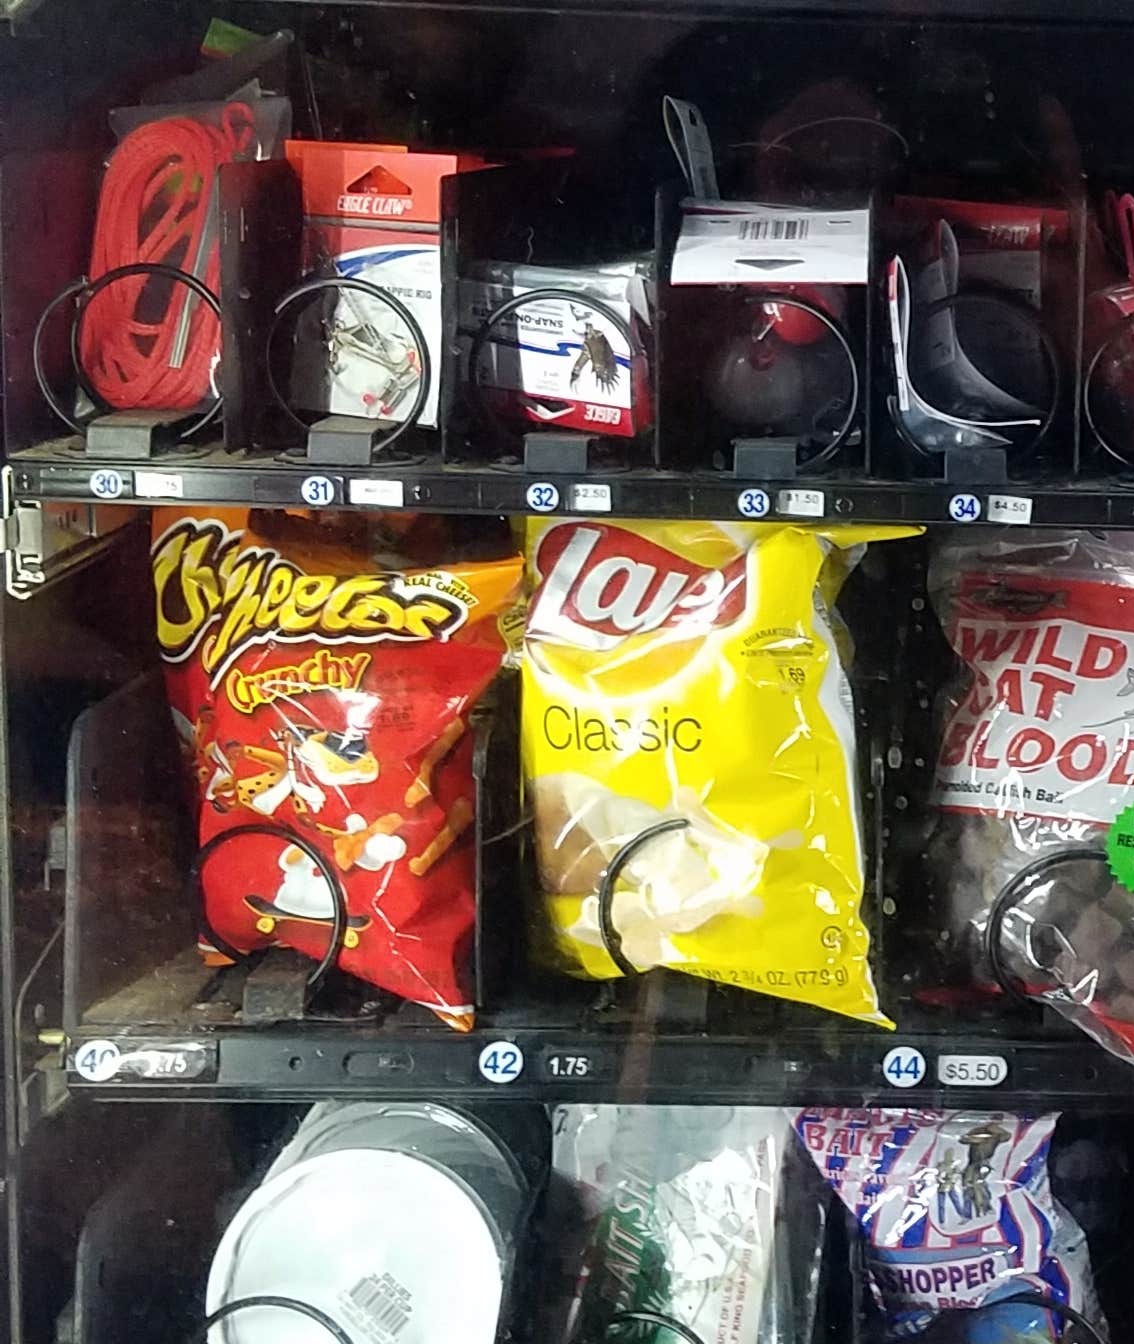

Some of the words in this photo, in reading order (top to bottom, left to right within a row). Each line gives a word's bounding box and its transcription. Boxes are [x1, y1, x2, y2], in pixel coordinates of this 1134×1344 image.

[94, 476, 118, 494] 30
[308, 481, 329, 500] 31
[532, 487, 554, 506] 32
[574, 488, 607, 499] $2.50
[743, 494, 764, 513] 33
[954, 498, 976, 518] 34
[993, 501, 1027, 512] $4.50
[153, 520, 458, 671] Cheetos
[960, 626, 1128, 680] WILD
[227, 650, 371, 713] Crunchy
[972, 670, 1076, 722] CAT
[543, 704, 702, 753] Classic
[484, 1049, 518, 1073] 42
[551, 1057, 587, 1075] 1.75
[887, 1055, 920, 1080] 44
[945, 1062, 1000, 1081] $5.50
[804, 1122, 893, 1157] BAIT
